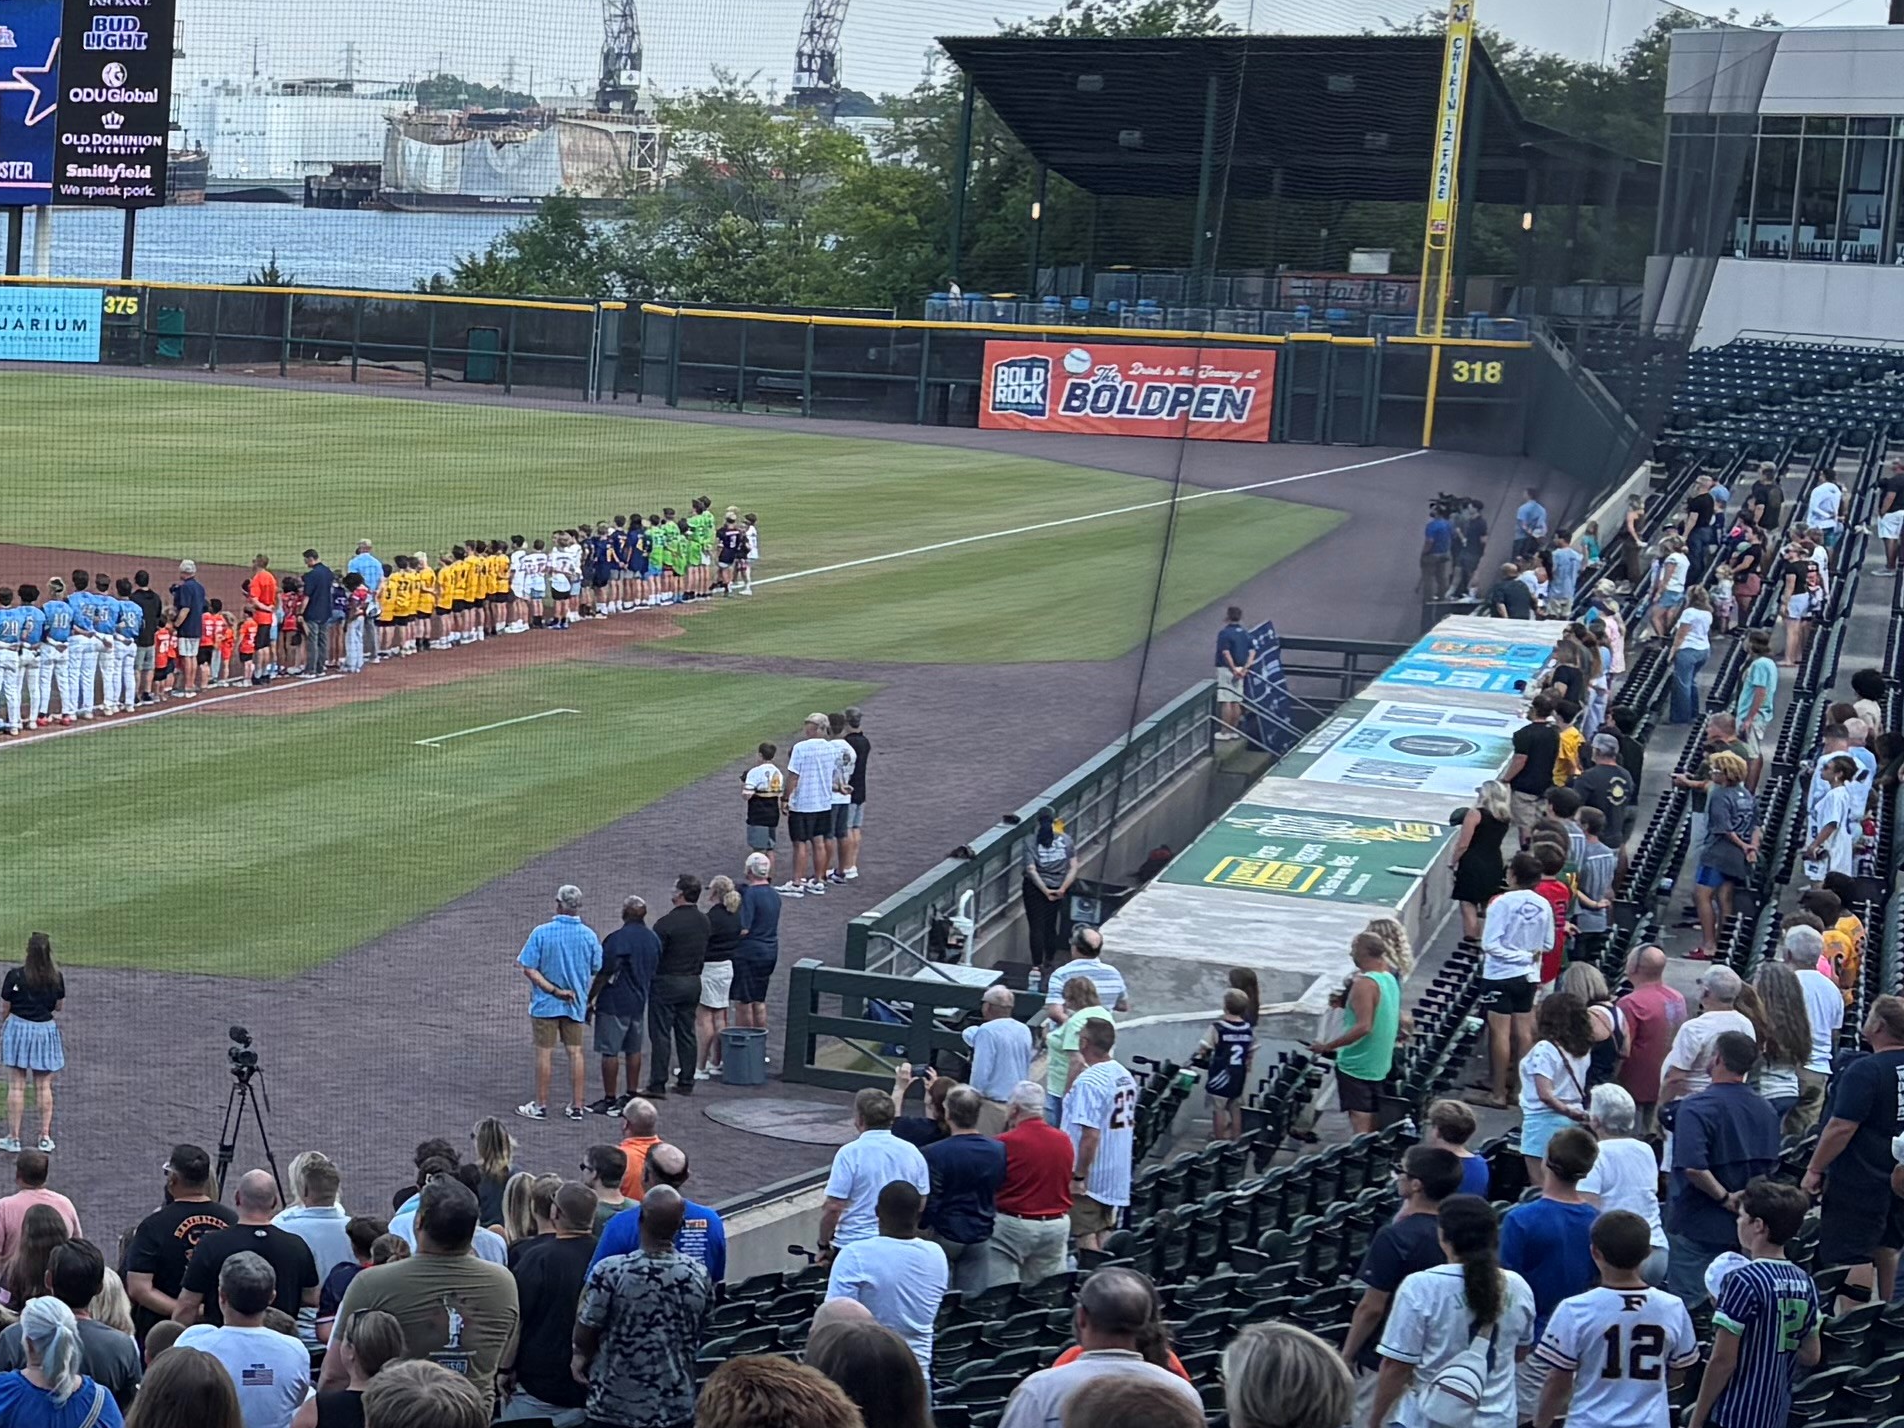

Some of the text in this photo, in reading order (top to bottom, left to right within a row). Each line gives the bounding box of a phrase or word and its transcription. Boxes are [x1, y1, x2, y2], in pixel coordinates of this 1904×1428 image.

[93, 16, 140, 33] BUD
[83, 32, 148, 50] LIGHT
[62, 133, 162, 146] OLD DOMINION
[66, 163, 152, 182] Smithfield
[60, 184, 80, 196] We
[82, 184, 121, 198] speak
[104, 295, 139, 316] 375
[996, 364, 1045, 385] BOLD
[1092, 366, 1121, 384] The
[1453, 361, 1502, 384] 318
[995, 384, 1045, 405] ROCK
[1061, 382, 1253, 421] BOLDPEN
[1230, 1045, 1244, 1065] 2
[1777, 1298, 1807, 1353] 12
[1602, 1324, 1664, 1380] 12
